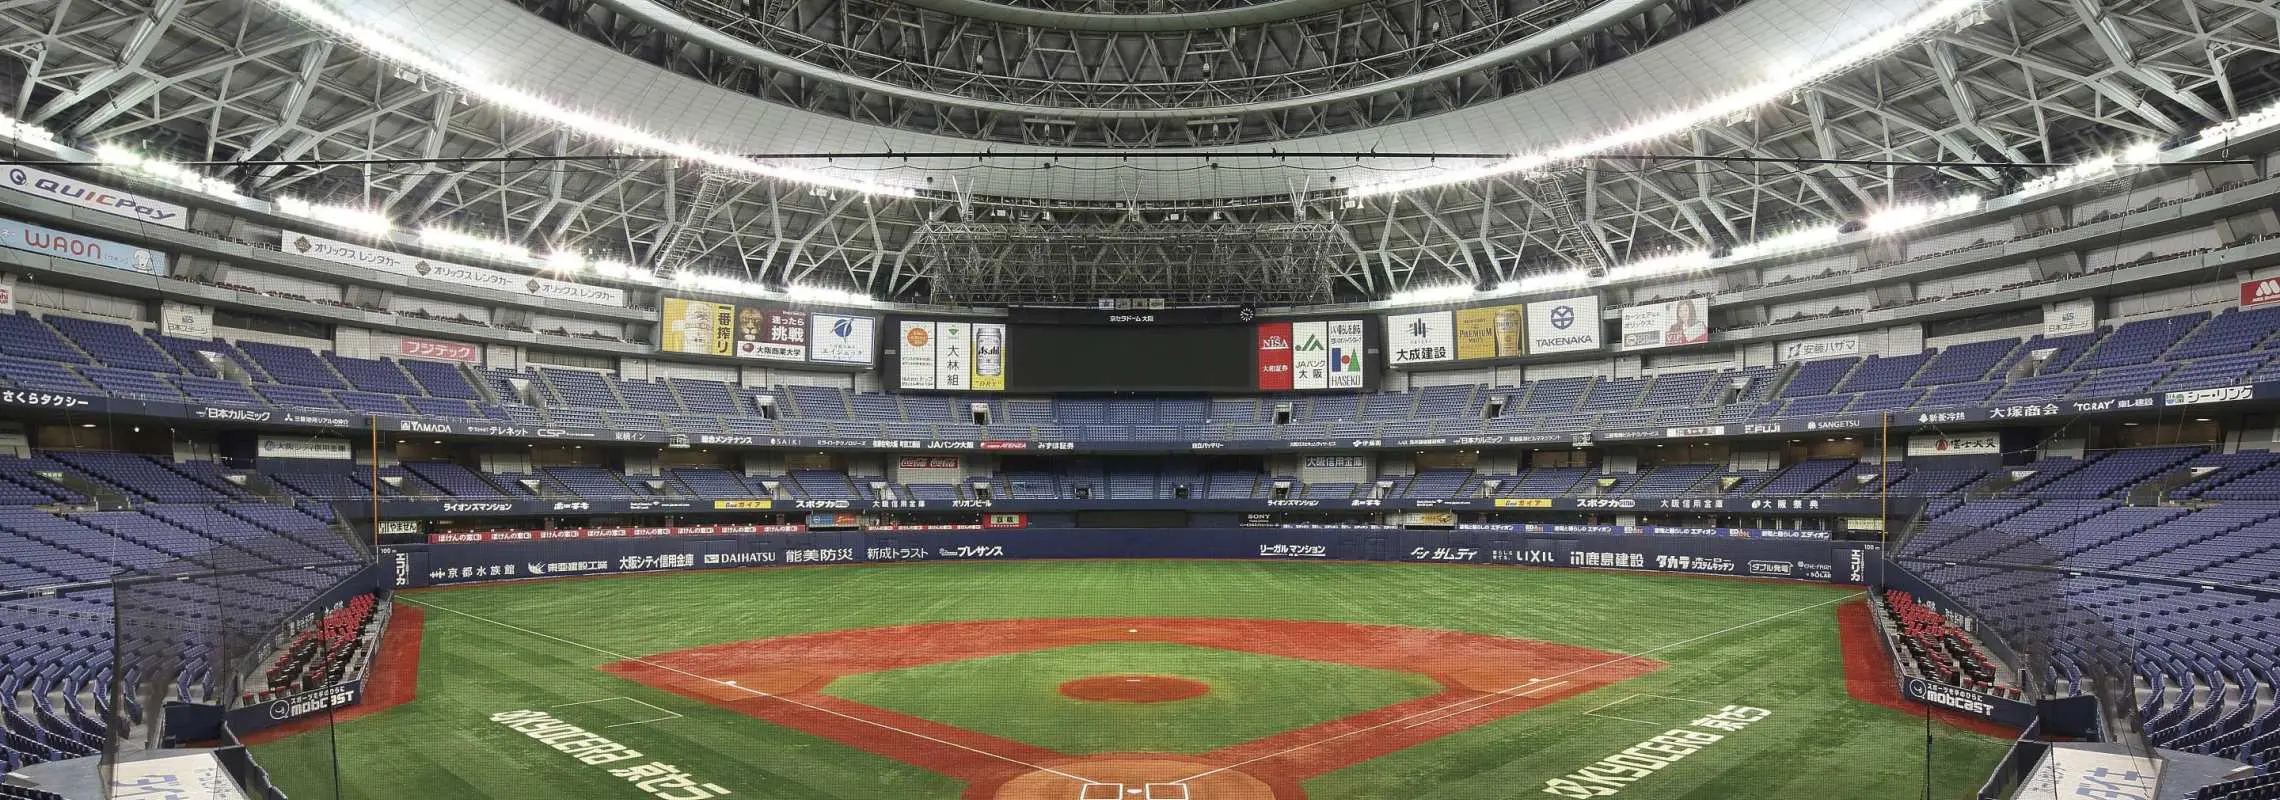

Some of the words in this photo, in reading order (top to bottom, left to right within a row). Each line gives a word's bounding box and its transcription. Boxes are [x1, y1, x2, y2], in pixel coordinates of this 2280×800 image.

[35, 178, 177, 220] QUICPay
[25, 229, 102, 260] WAON
[717, 305, 732, 353] 一番搾り
[1263, 339, 1288, 348] NISA
[1535, 335, 1593, 347] TAKENAKA
[1804, 339, 1856, 354] 安藤ハザマ
[406, 341, 470, 358] フジテック
[978, 346, 999, 355] Asahi
[1396, 346, 1447, 362] 大成建設
[947, 344, 960, 386] 大林組
[1296, 360, 1325, 369] JAバンク
[1299, 369, 1322, 379] 大阪
[1332, 375, 1361, 387] HASEKO
[3, 390, 89, 407] さくらタクシー
[2117, 398, 2153, 408] 東レ建設
[208, 406, 270, 422] 日本カルミック
[1989, 403, 2060, 419] 大塚商会
[411, 421, 452, 433] YAMADA
[489, 426, 529, 437] テレネット
[1817, 420, 1860, 431] SANGETSU
[536, 429, 566, 438] CSP
[615, 432, 646, 441] 東横イン
[927, 440, 974, 449] JAバンク大阪
[1037, 441, 1074, 450] みずほ証券
[1461, 436, 1504, 445] 日本カルミック
[1950, 438, 1996, 449] 富士火災
[1306, 456, 1364, 468] 大阪信用金庫
[443, 503, 512, 512] ライオンズマンション
[795, 500, 836, 508] スポタカ
[952, 499, 992, 508] オリオンビール
[1576, 499, 1620, 508] スポタカ
[1660, 499, 1724, 509] 大阪信用金庫
[1763, 499, 1819, 510] 大阪祭典
[438, 533, 482, 542] ほけんの窓口
[491, 532, 532, 541] ほけんの窓口
[540, 531, 579, 539] ほけんの窓口
[587, 529, 626, 538] ほけんの窓口
[634, 528, 670, 536] ほけんの窓口
[1690, 528, 1717, 536] エディオン
[1800, 530, 1830, 539] エディオン
[785, 546, 853, 563] 能美防災
[866, 547, 929, 560] 新成トラスト
[958, 545, 1004, 557] プレサンス
[1260, 544, 1326, 554] リーガルマンション
[1432, 547, 1478, 561] サムティ
[619, 553, 694, 571] 大阪シティ信用金庫
[721, 552, 776, 563] DAIHATSU
[1516, 549, 1555, 563] LIXIL
[1585, 552, 1645, 568] 鹿島建設
[1656, 555, 1690, 569] タカラ
[396, 552, 406, 586] エコリカ
[448, 563, 516, 579] 京都水族館
[547, 560, 608, 574] 東亜建設工業
[1851, 549, 1861, 582] エコリカ
[1690, 704, 1772, 732] 京セラ
[500, 710, 644, 766] KYOCERA
[1565, 728, 1725, 788] KYOCERA
[607, 761, 733, 800] 京セラ
